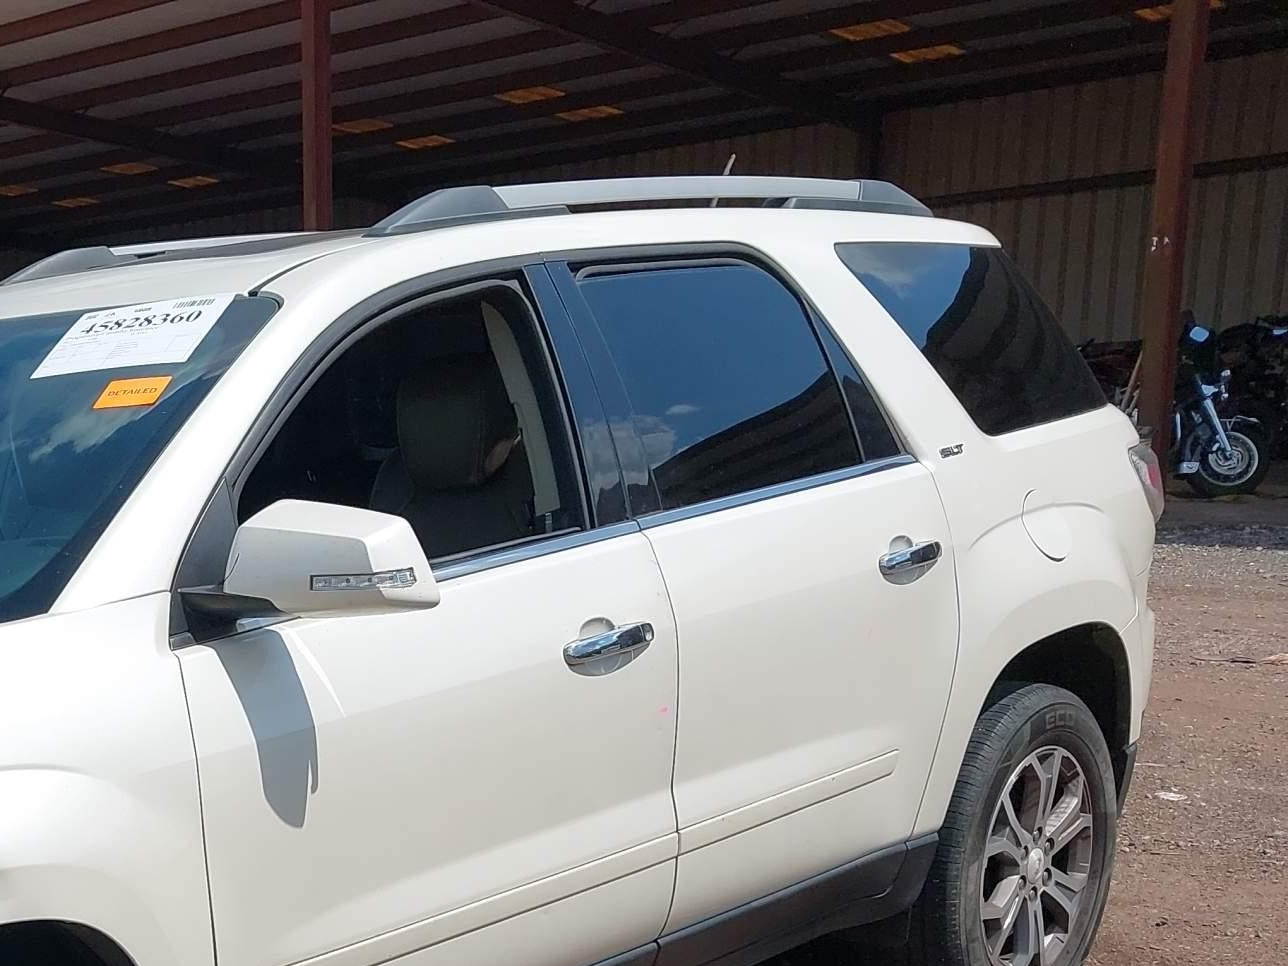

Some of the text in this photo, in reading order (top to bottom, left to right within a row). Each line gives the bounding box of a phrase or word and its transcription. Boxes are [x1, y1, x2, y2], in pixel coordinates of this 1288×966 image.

[80, 310, 202, 334] 45828360
[107, 387, 158, 397] DETAILED
[938, 443, 964, 459] SLT
